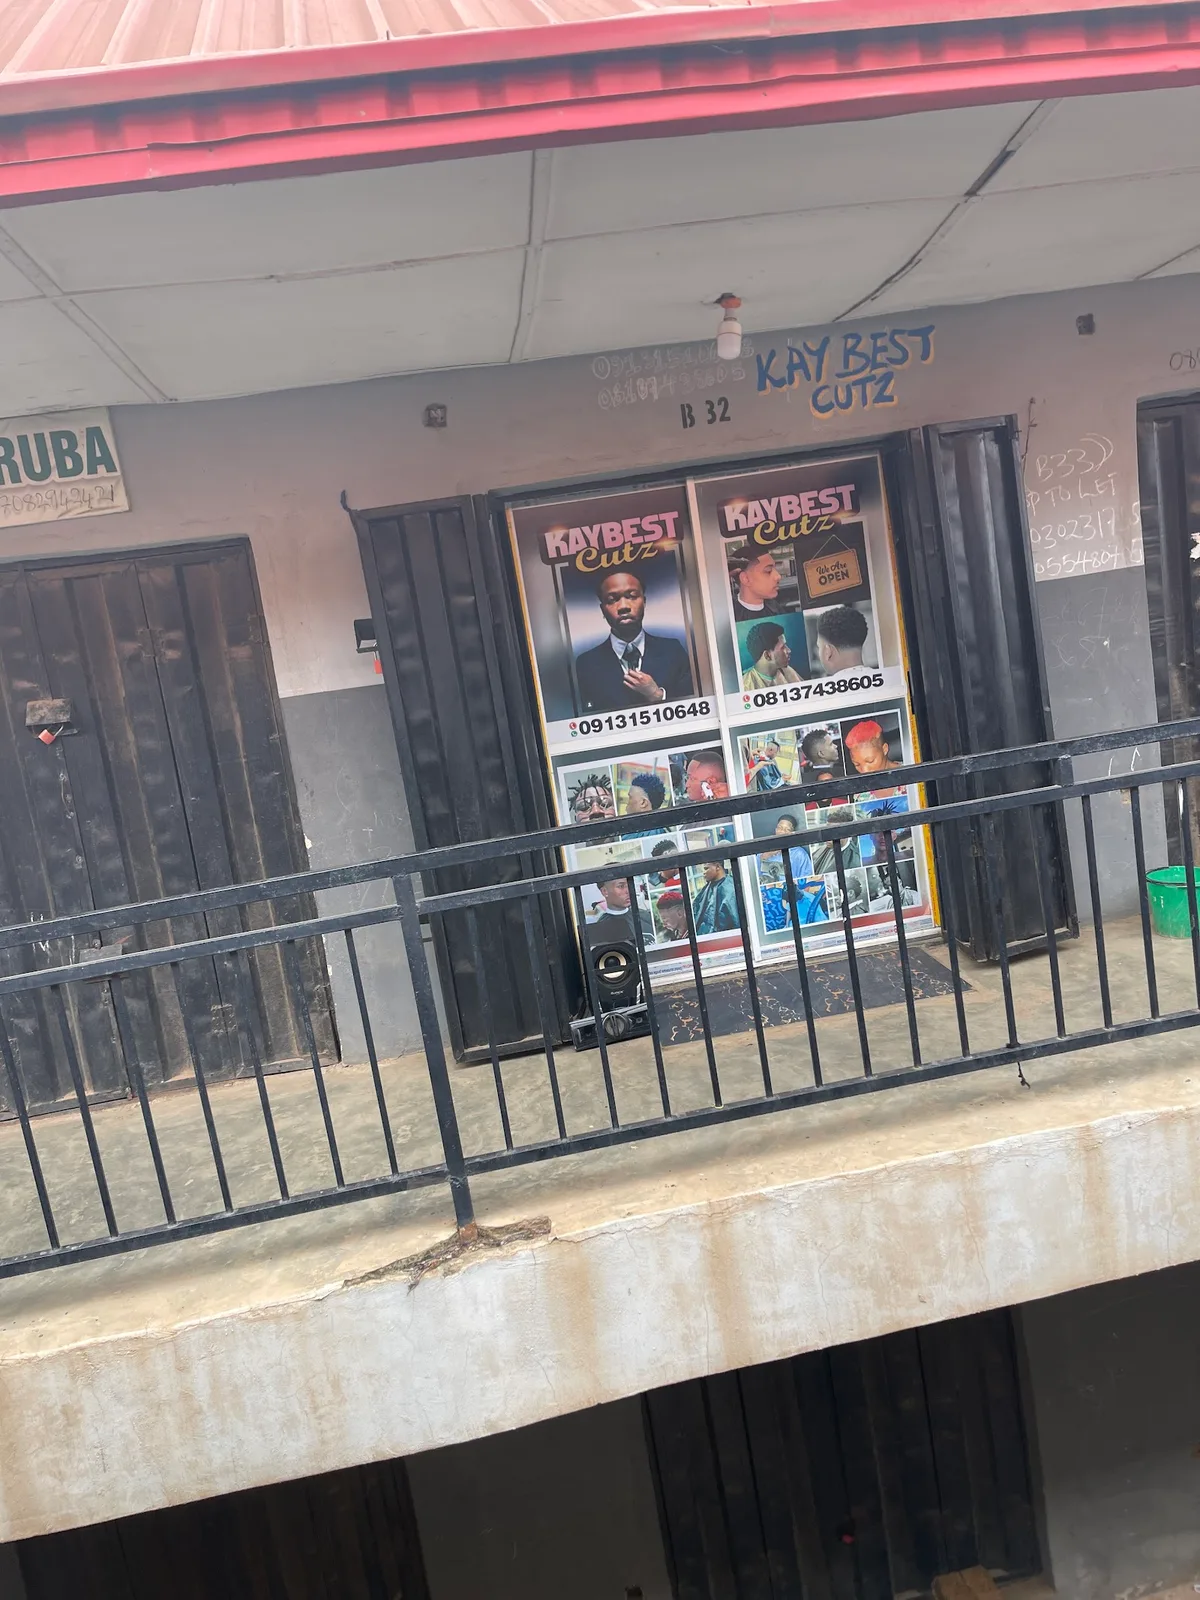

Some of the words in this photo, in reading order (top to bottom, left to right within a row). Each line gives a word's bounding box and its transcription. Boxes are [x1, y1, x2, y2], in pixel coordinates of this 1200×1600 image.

[756, 336, 831, 395] KAY
[838, 325, 936, 378] BEST
[1169, 347, 1200, 371] 08
[810, 371, 899, 419] CUTZ
[681, 403, 696, 429] B
[705, 396, 732, 425] 32
[1079, 471, 1117, 499] LET
[724, 484, 856, 532] KAYBEST
[544, 511, 679, 558] KAYBEST
[753, 515, 835, 545] Cutz
[575, 541, 658, 573] Cutz
[816, 564, 829, 575] We
[830, 561, 847, 571] Are
[818, 569, 849, 585] OPEN
[753, 673, 885, 708] 08137438605
[578, 701, 710, 736] 09131510648
